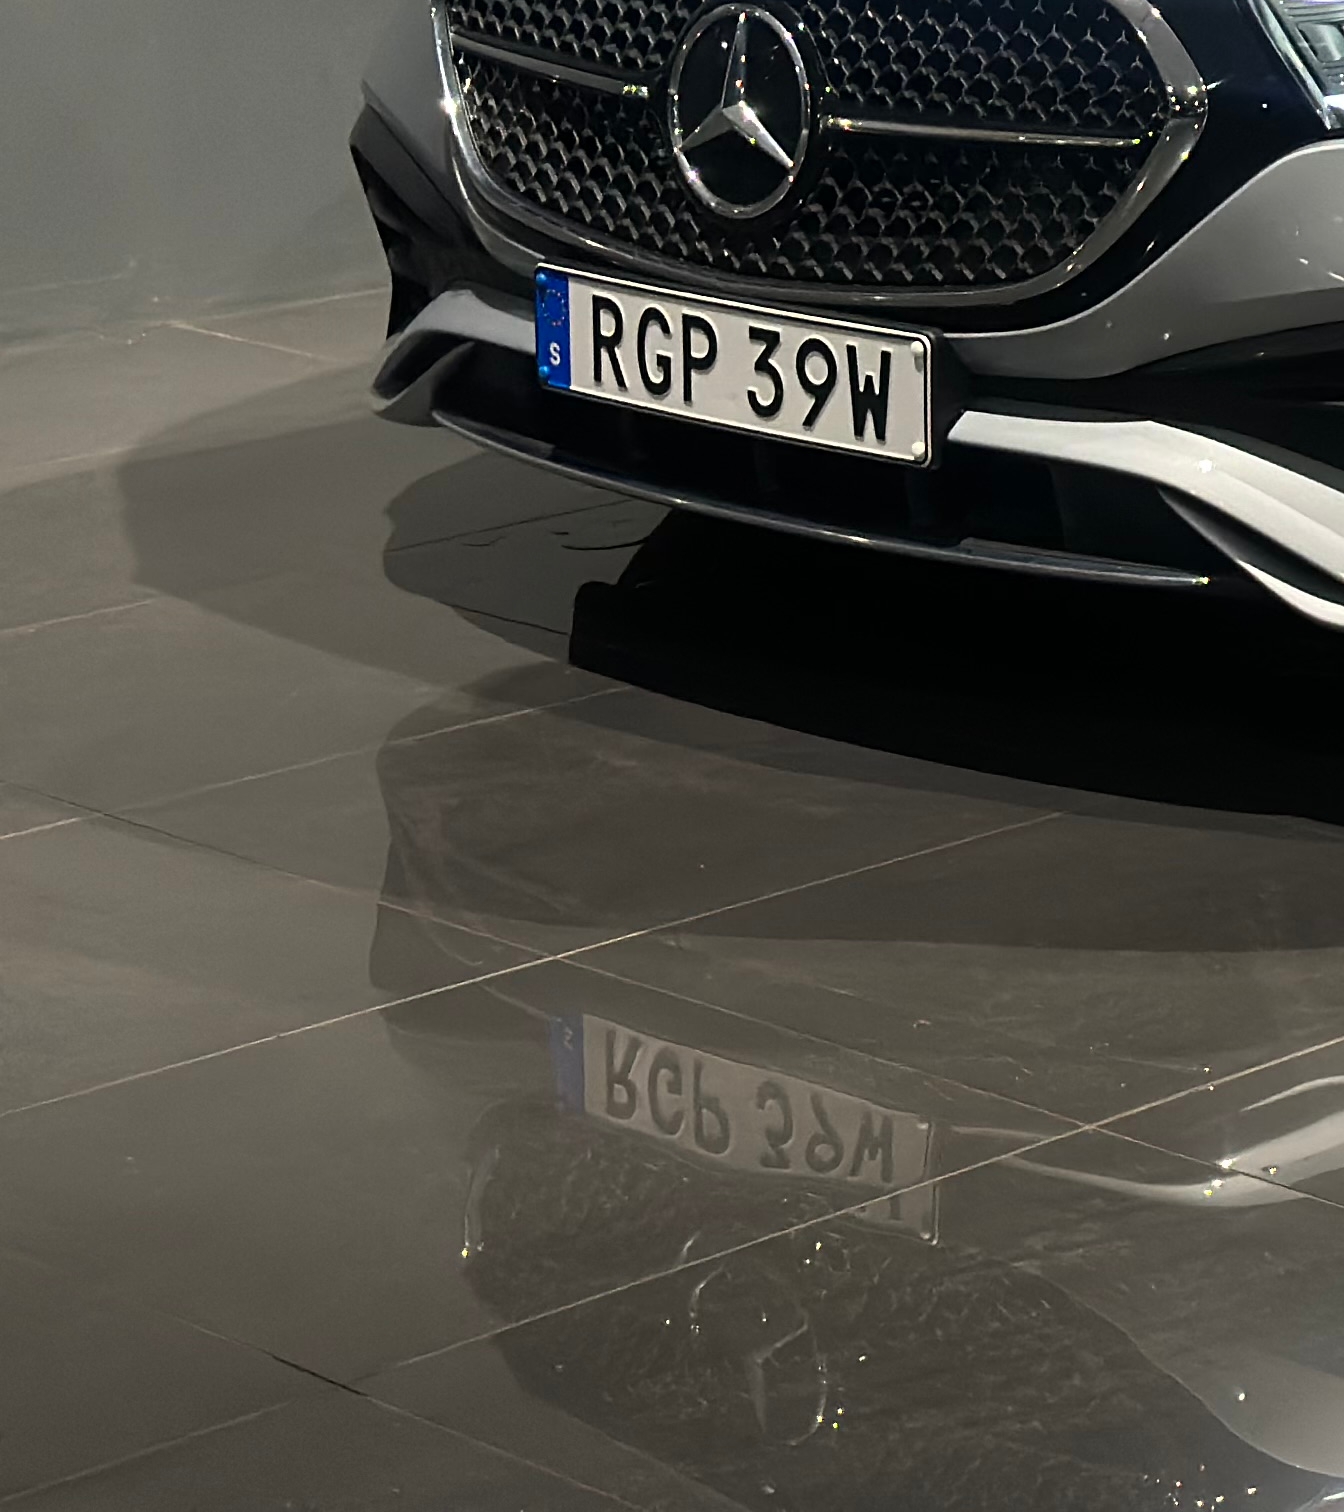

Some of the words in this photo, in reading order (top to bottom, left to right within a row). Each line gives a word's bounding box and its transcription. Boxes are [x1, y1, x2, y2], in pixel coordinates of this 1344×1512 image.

[548, 342, 561, 367] S
[591, 293, 718, 404] RGP
[746, 324, 892, 444] 39W
